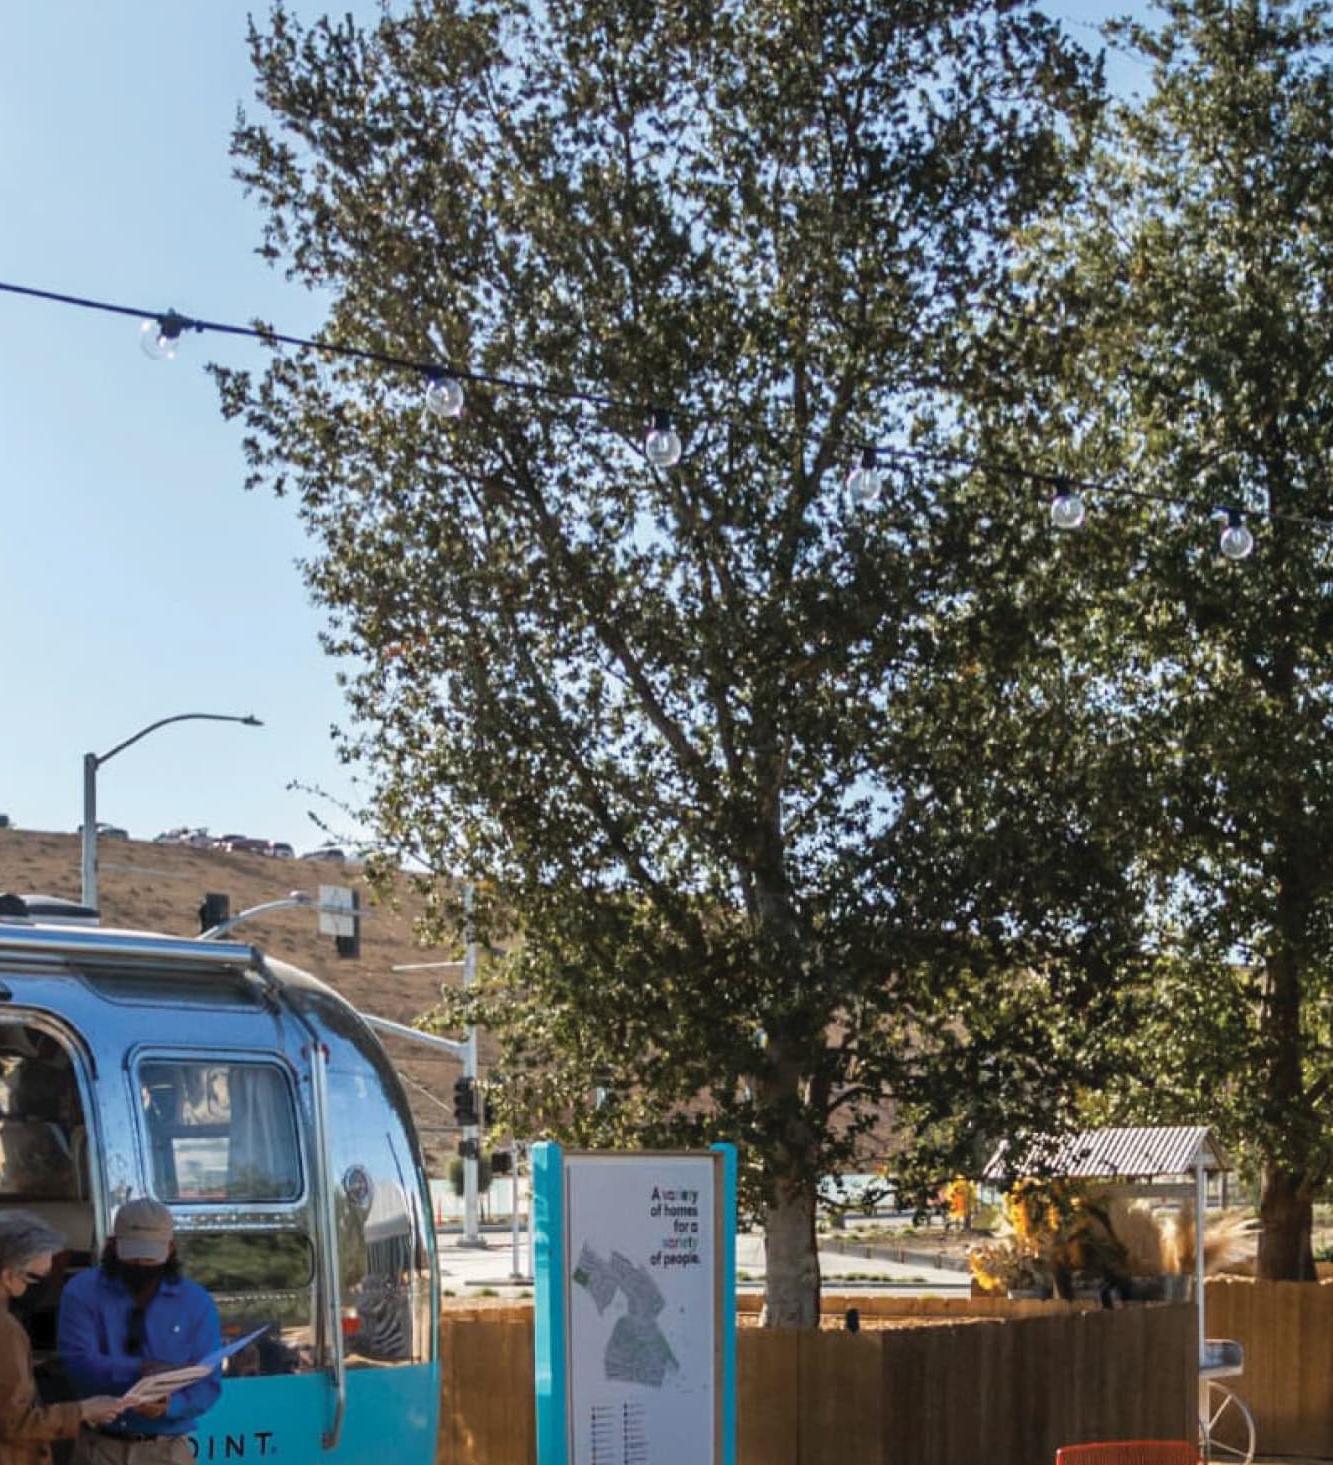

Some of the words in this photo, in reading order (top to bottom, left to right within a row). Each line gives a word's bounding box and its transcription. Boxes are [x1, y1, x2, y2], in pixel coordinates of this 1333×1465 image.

[650, 1203, 661, 1218] of
[664, 1203, 699, 1218] homes
[674, 1218, 689, 1233] for
[650, 1250, 661, 1266] of
